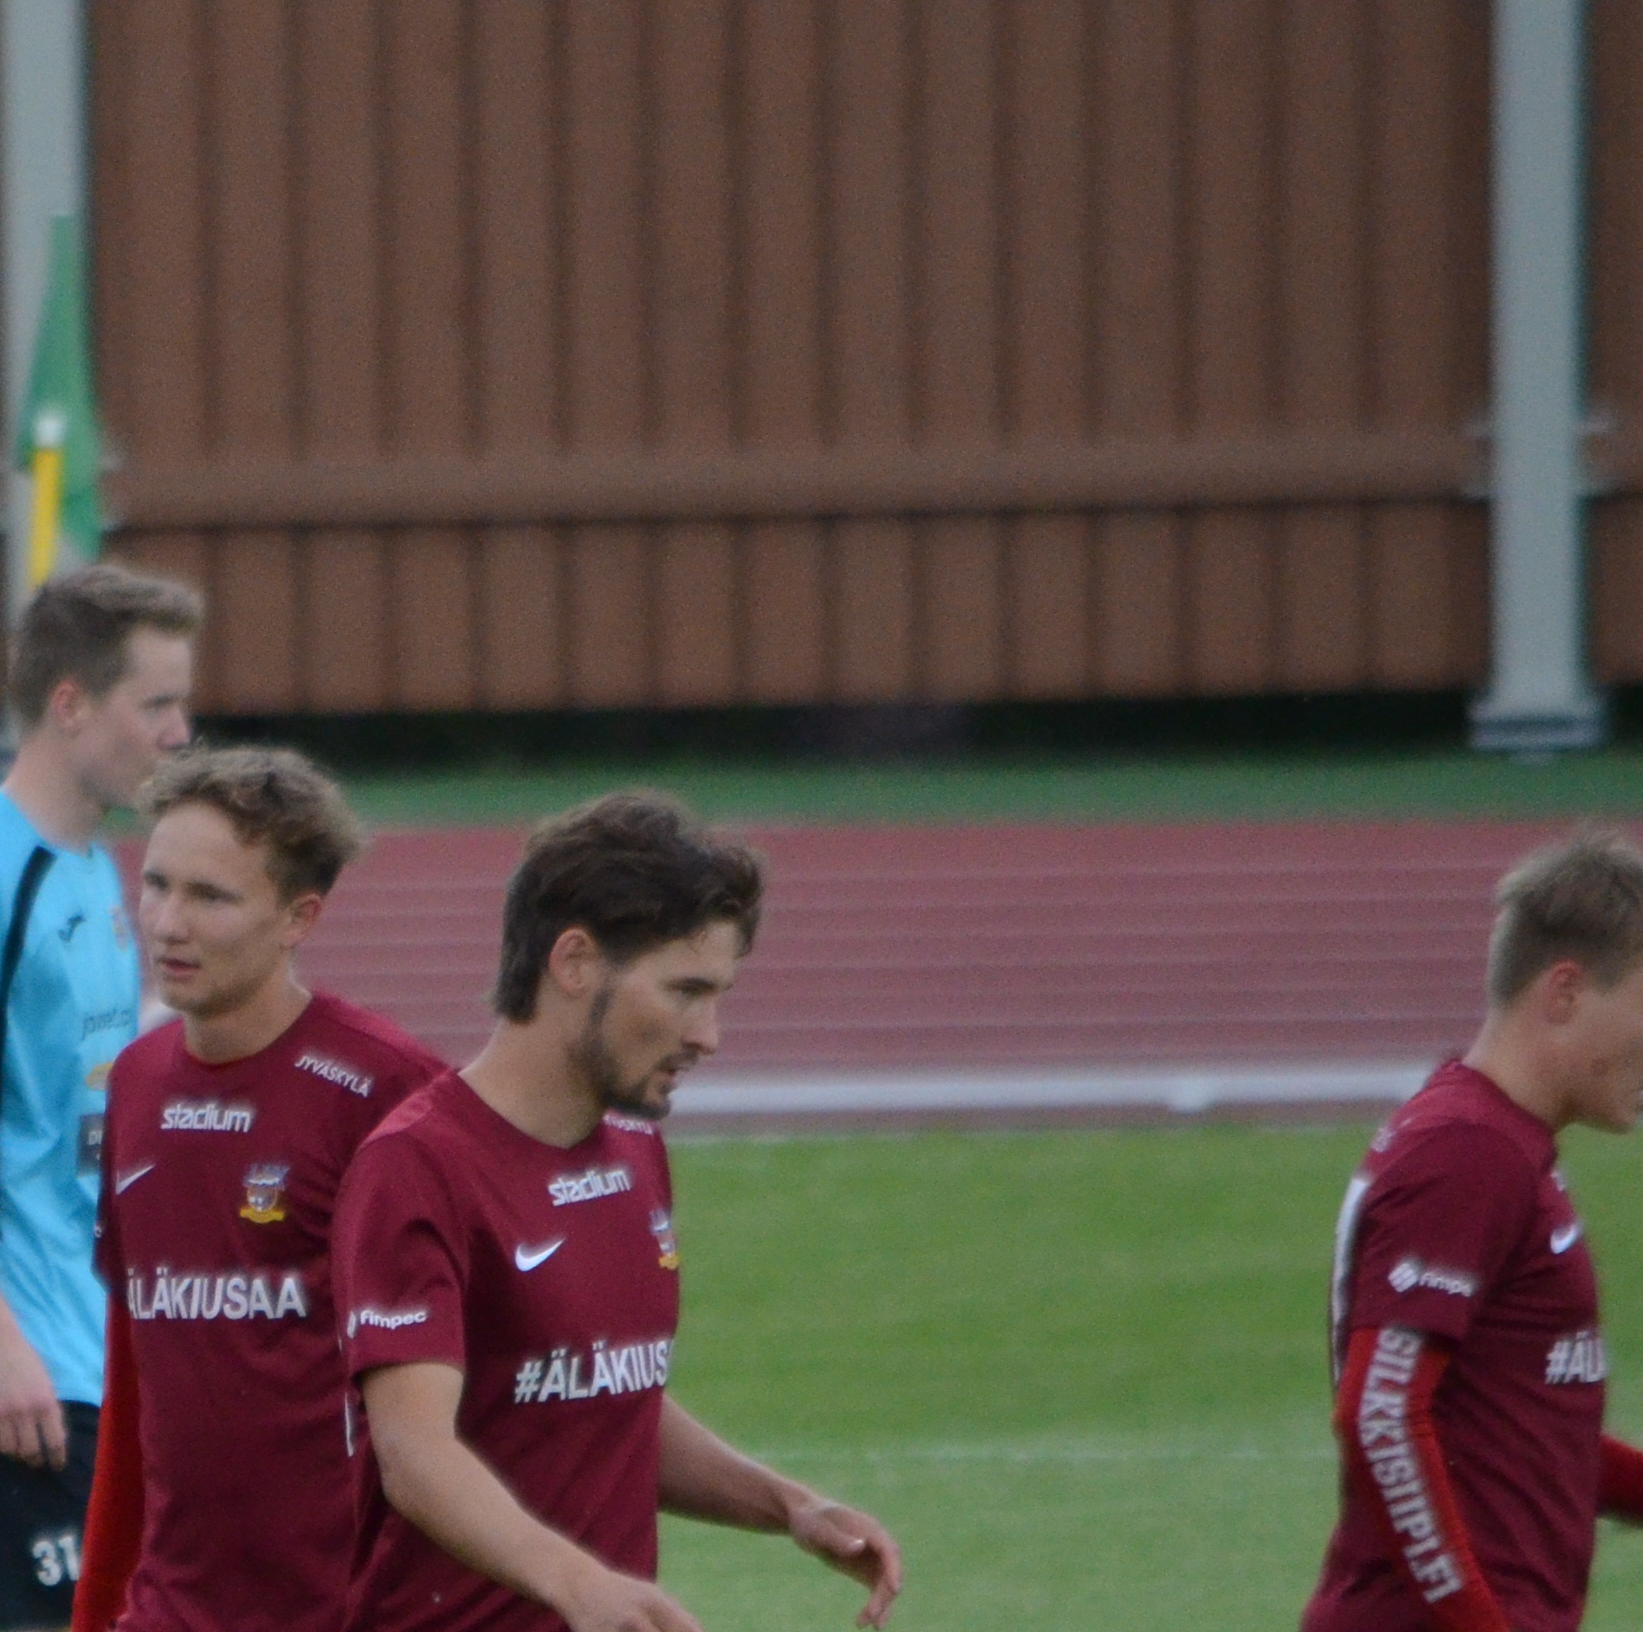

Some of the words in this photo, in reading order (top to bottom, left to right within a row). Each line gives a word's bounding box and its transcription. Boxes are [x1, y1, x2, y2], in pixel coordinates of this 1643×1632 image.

[160, 1103, 252, 1133] stadium
[547, 1169, 632, 1207] stadium
[360, 1309, 428, 1330] fimpec
[32, 1534, 81, 1587] 31
